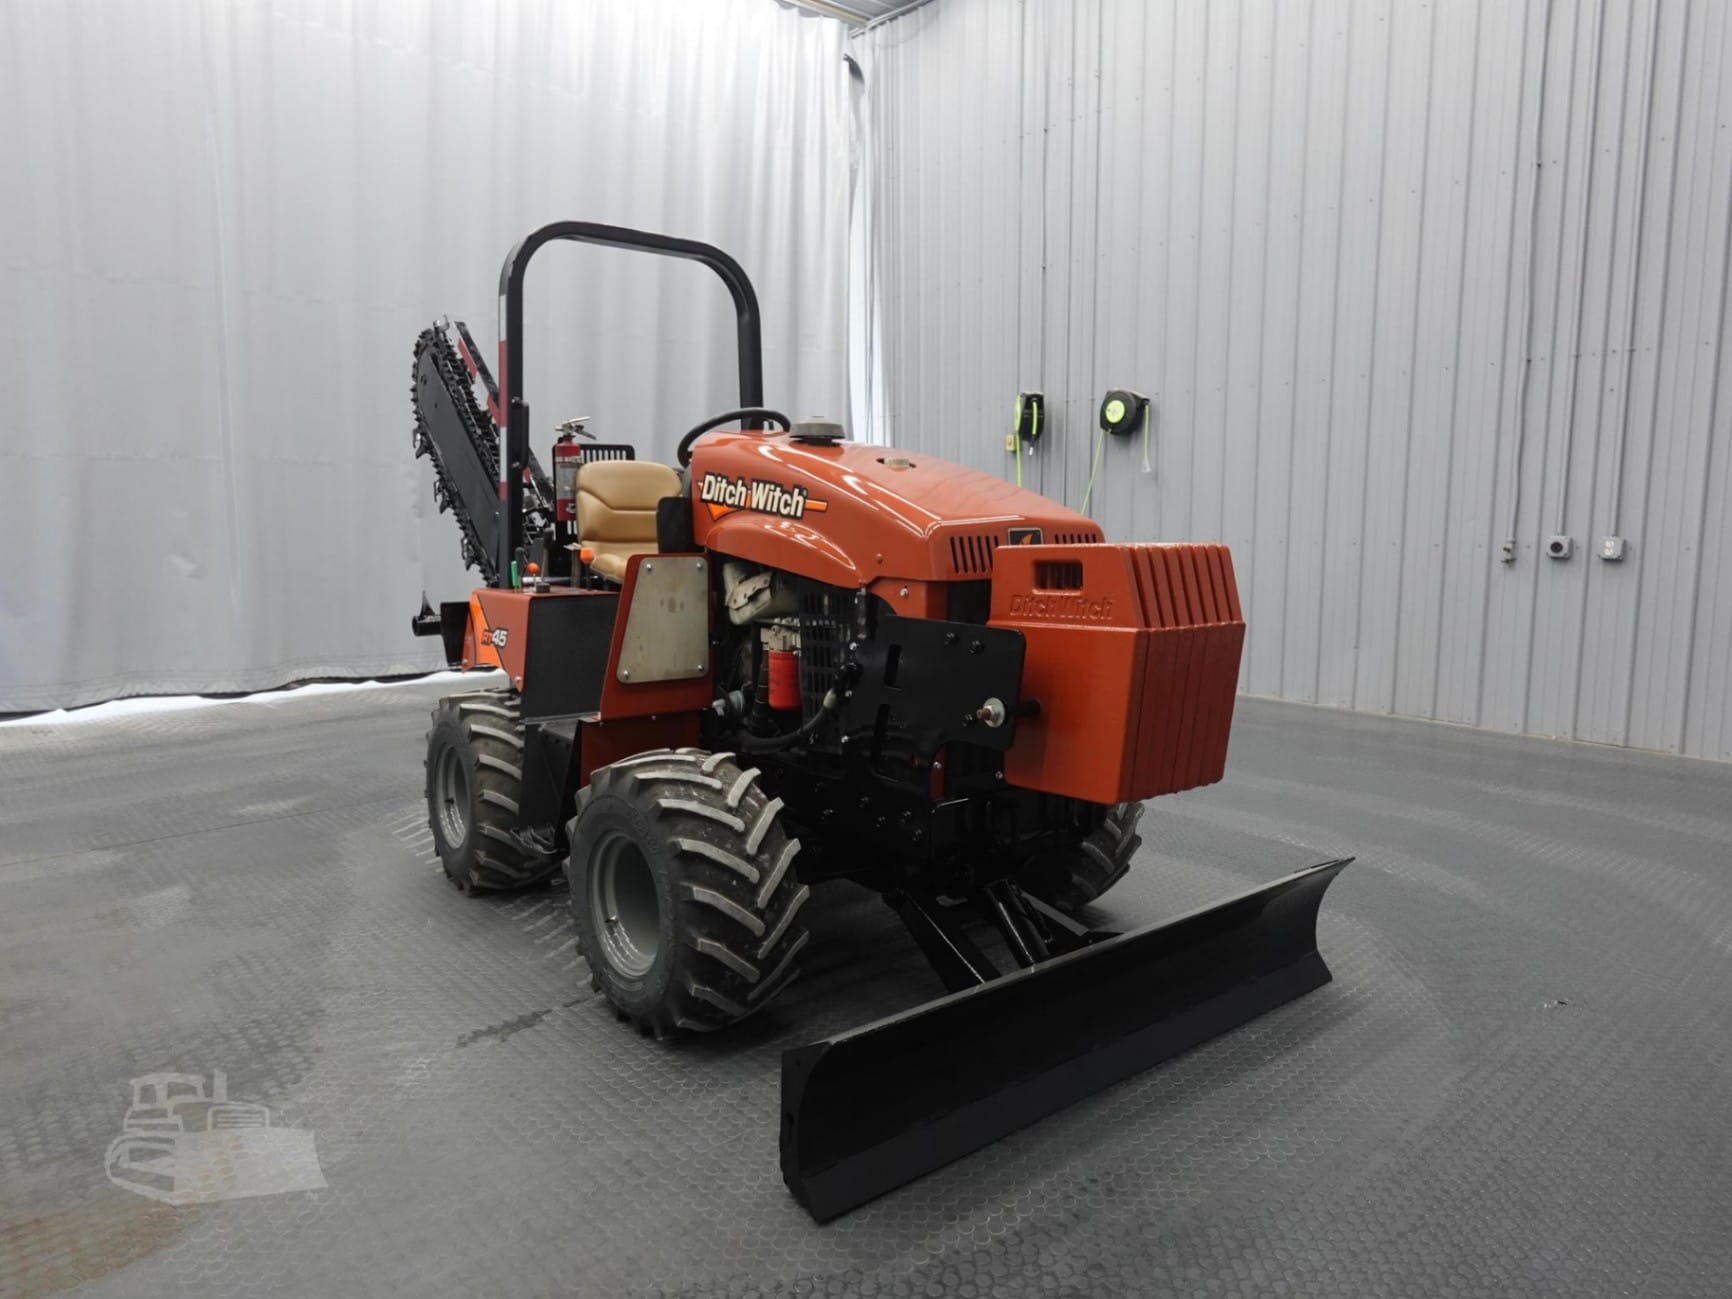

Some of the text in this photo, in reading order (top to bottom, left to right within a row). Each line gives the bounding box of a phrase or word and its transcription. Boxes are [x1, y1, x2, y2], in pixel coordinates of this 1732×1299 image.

[701, 473, 805, 518] Ditch Witch
[1009, 594, 1113, 620] Ditch Witch
